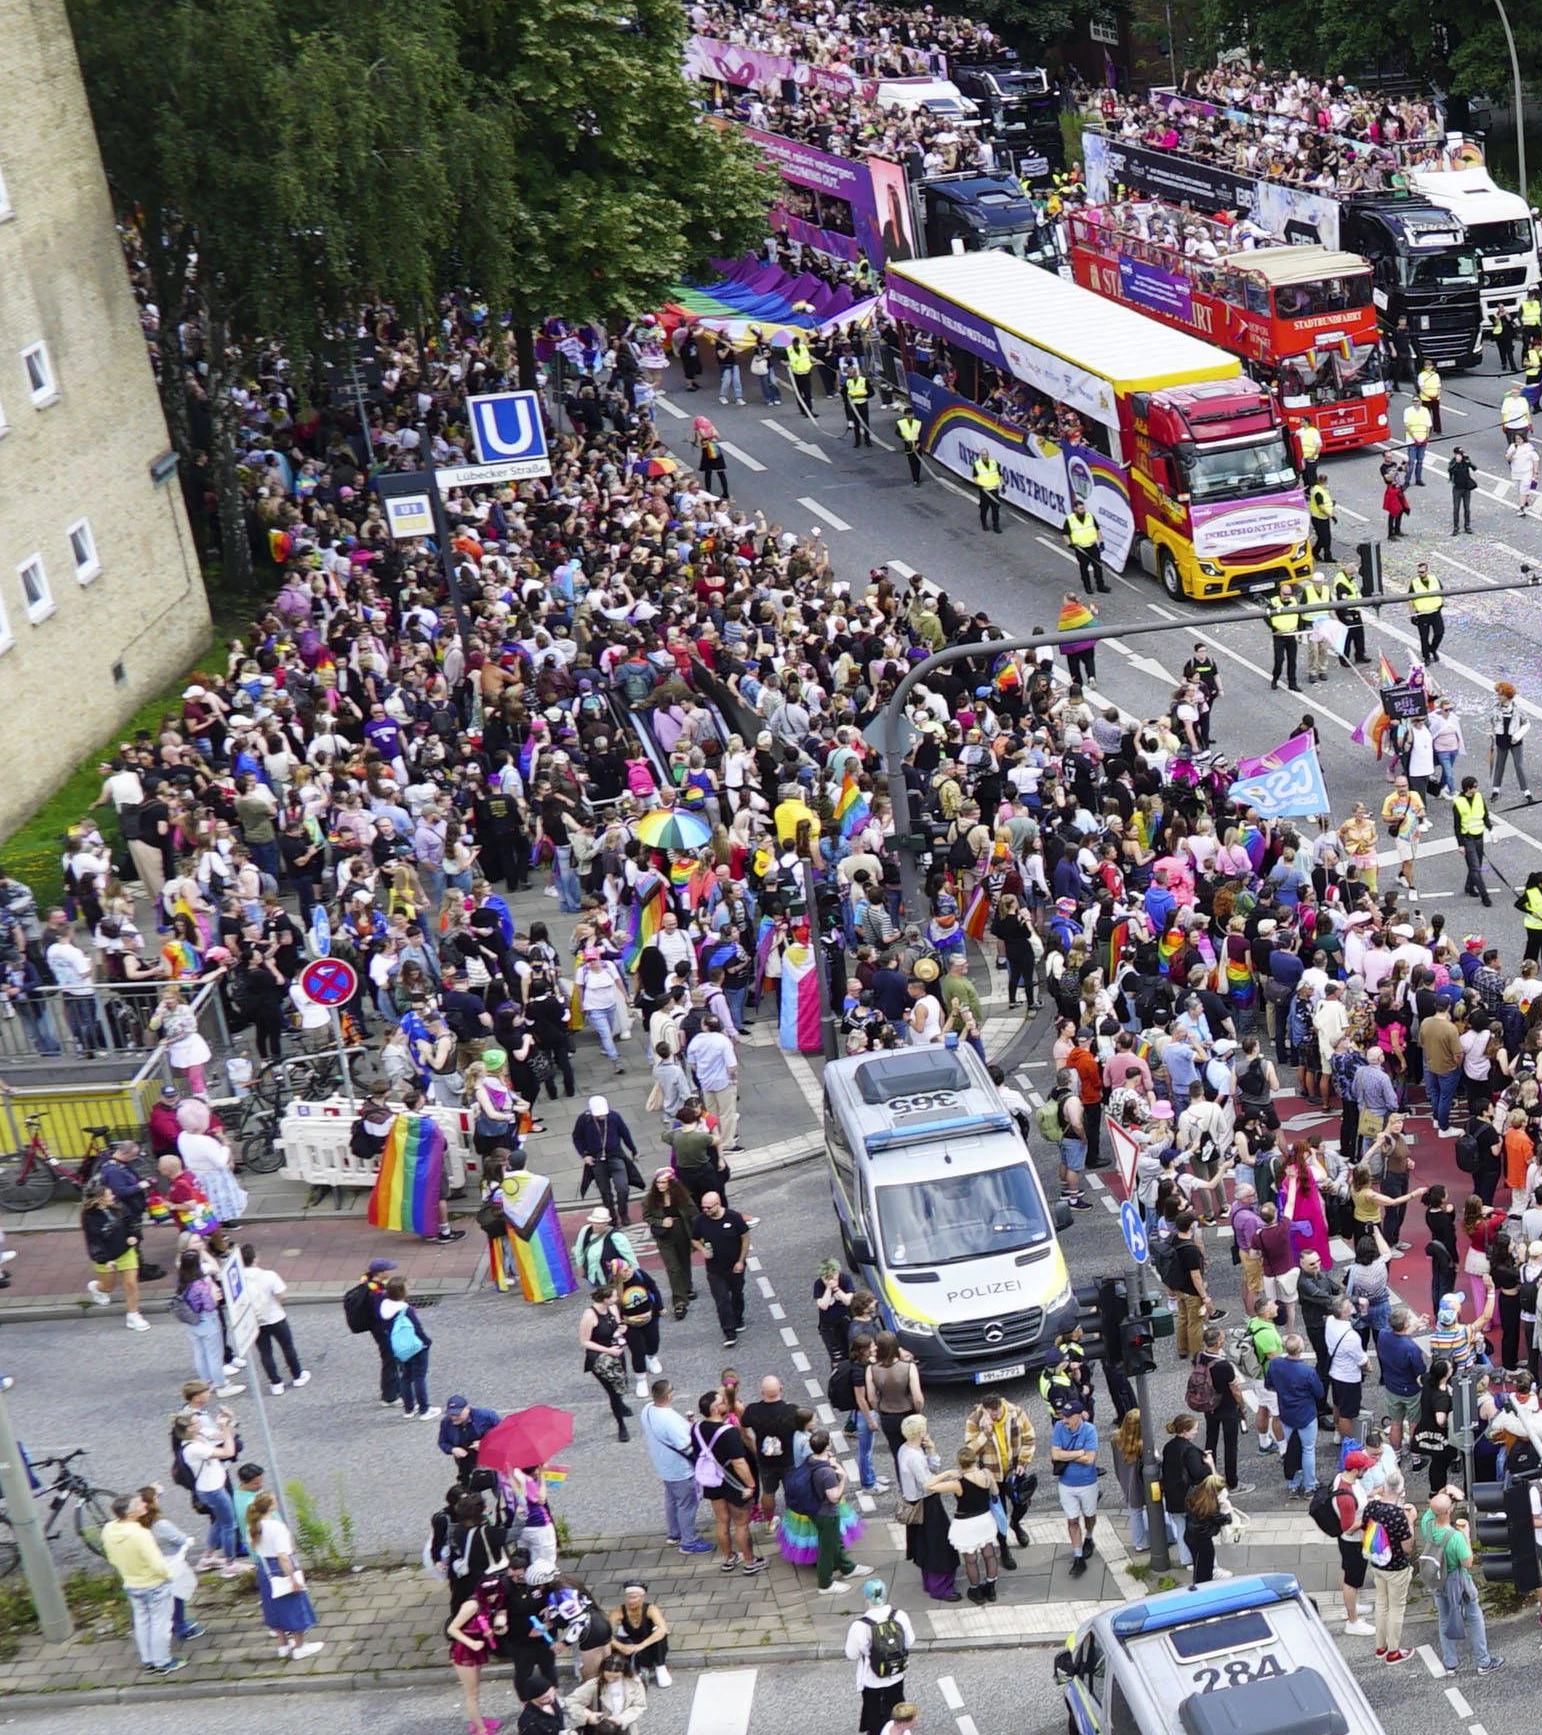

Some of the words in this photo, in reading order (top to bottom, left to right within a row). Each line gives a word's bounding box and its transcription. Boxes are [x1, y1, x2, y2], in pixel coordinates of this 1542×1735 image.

[1293, 311, 1362, 330] STADTRUNDFAHRT
[480, 400, 533, 455] U
[457, 469, 508, 482] Lübecker
[510, 464, 546, 476] Straße
[958, 442, 1066, 514] INKONSTRUCK
[1205, 518, 1301, 541] INKLUSIONSTRUCK
[889, 1092, 958, 1114] 365
[947, 1280, 1022, 1303] POLIZEI
[1193, 1654, 1288, 1695] 284
